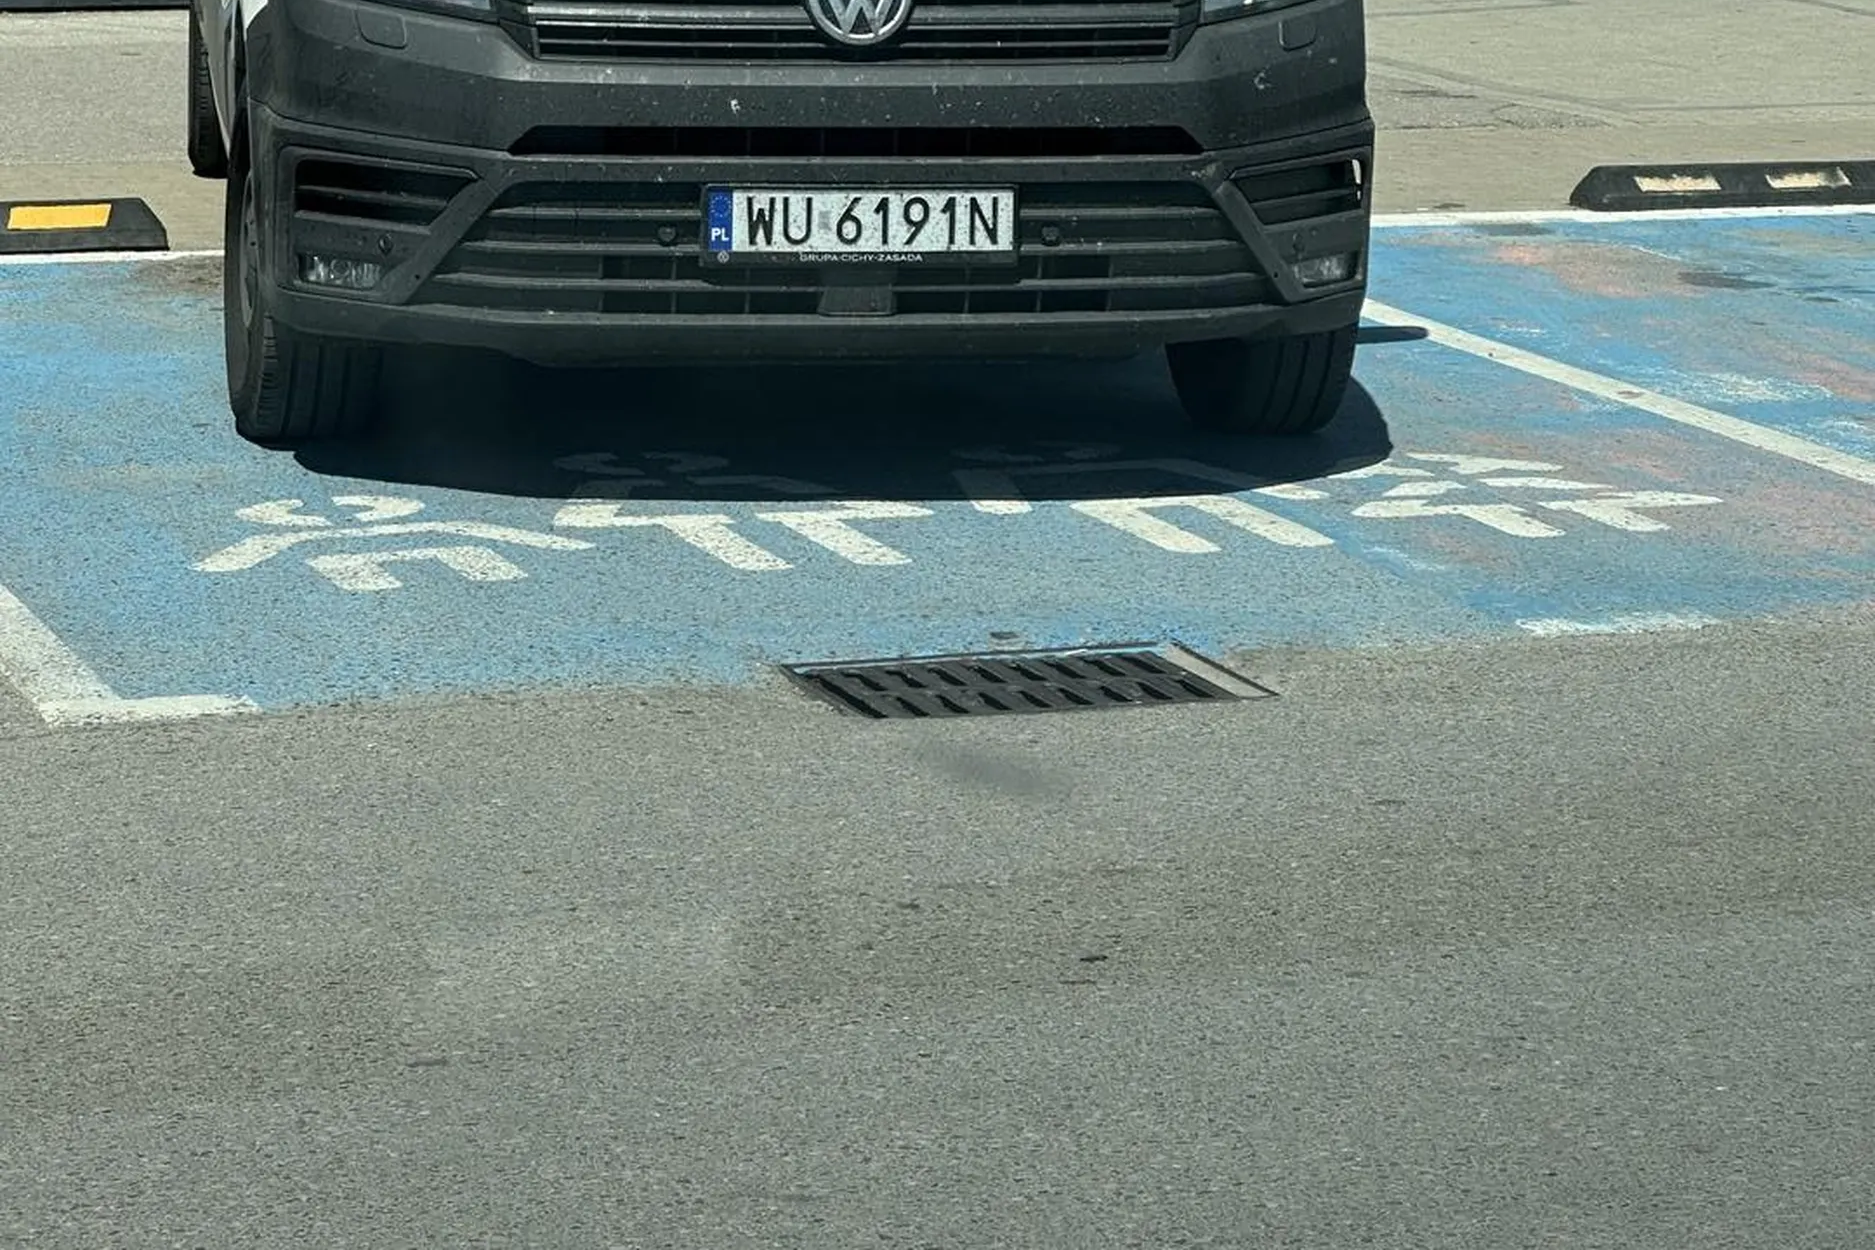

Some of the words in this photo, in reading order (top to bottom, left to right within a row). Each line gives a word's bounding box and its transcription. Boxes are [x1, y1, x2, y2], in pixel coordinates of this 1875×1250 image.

[747, 196, 813, 246] WU
[836, 196, 999, 246] 6191N
[711, 227, 730, 241] PL
[800, 253, 839, 262] GRUPA
